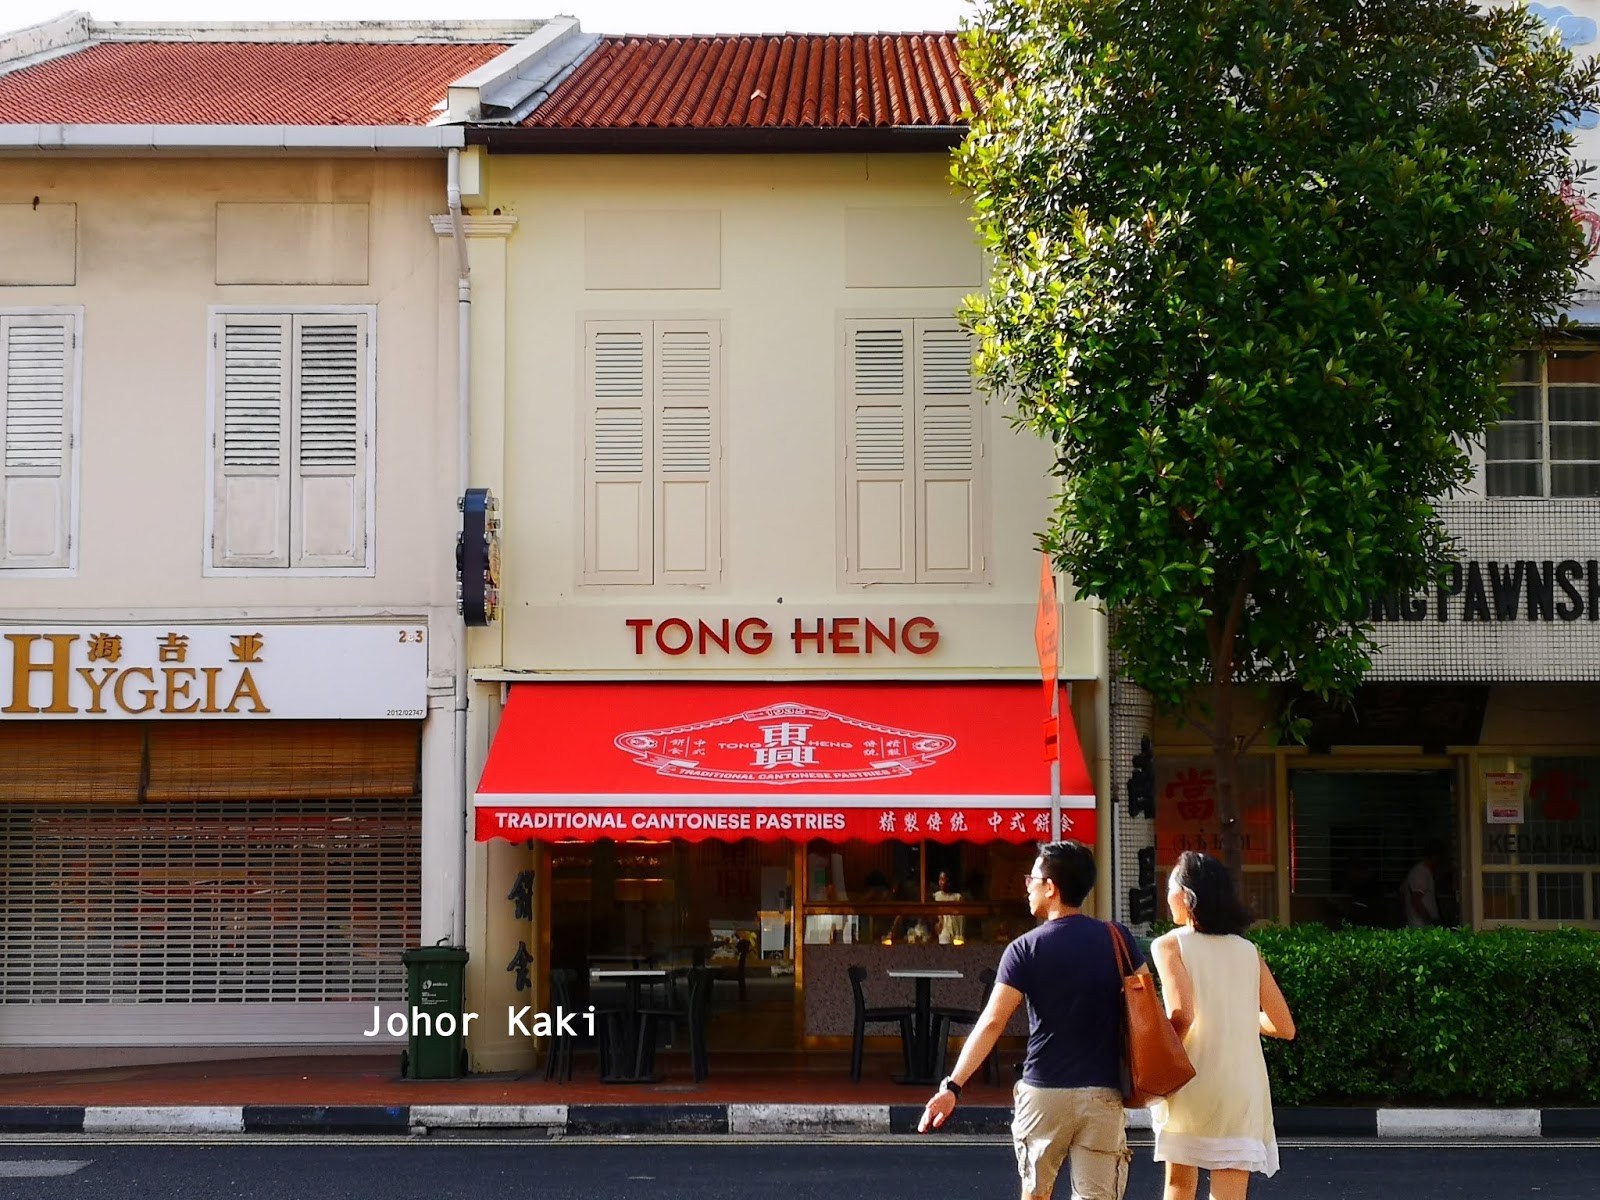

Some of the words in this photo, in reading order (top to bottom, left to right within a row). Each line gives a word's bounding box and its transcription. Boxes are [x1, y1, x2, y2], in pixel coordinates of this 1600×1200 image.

[87, 632, 264, 663] 海吉亚
[625, 617, 773, 656] TONG
[790, 616, 940, 656] HENG
[1, 633, 271, 713] HYGEIA
[717, 742, 762, 750] TONG
[807, 740, 853, 749] HENG
[678, 768, 756, 780] TRADITIONAL
[757, 771, 832, 781] CANTONESE
[833, 769, 890, 780] PASTRIES
[494, 811, 627, 830] TRADITIONAL
[631, 812, 751, 830] CANTONESE
[755, 812, 846, 830] PASTRIES
